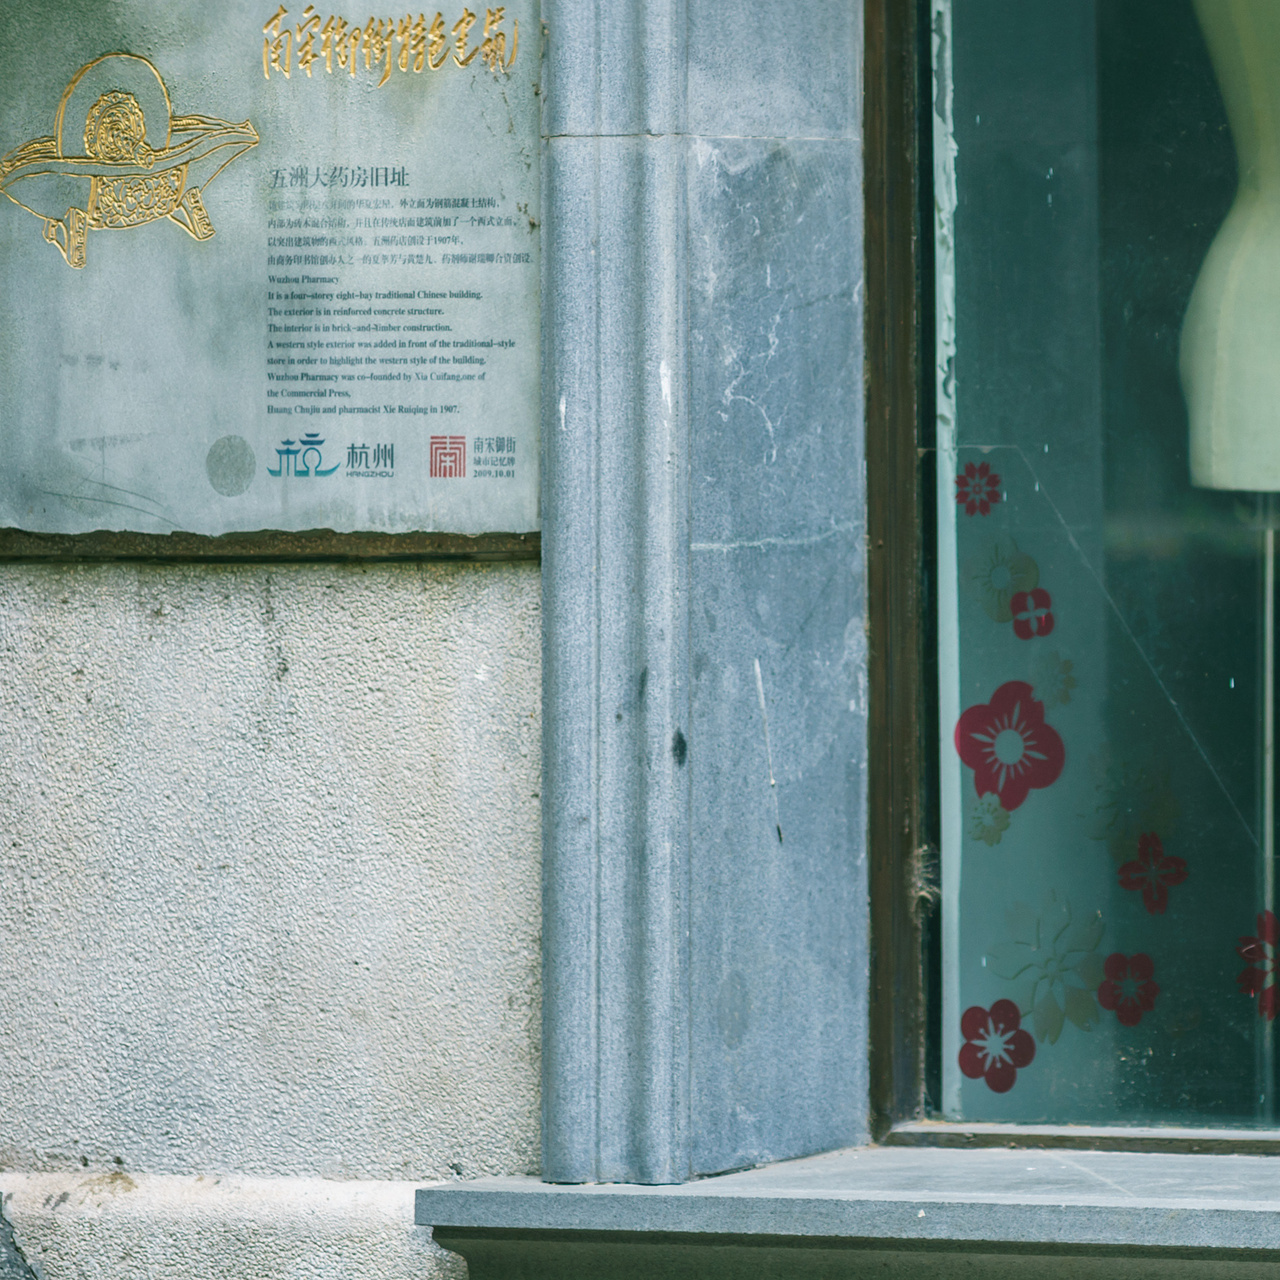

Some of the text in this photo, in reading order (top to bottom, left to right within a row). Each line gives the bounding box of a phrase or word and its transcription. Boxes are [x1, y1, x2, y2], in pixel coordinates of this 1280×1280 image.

[270, 166, 409, 188] 五洲大药房旧址
[268, 275, 339, 285] Wuzhou Pharmacy
[375, 291, 415, 299] traditional
[417, 290, 447, 299] Chinese
[449, 290, 483, 300] building.
[284, 307, 314, 316] exterior
[333, 307, 372, 316] reinforced
[373, 307, 406, 315] concrete
[407, 306, 444, 315] structure.
[284, 323, 312, 332] interior
[403, 322, 452, 331] construction.
[276, 340, 305, 349] western
[307, 340, 324, 350] style
[326, 340, 355, 348] exterior
[373, 339, 397, 348] added
[408, 339, 427, 348] front
[267, 357, 286, 365] store
[296, 356, 318, 365] order
[329, 356, 363, 366] highlight
[379, 356, 408, 364] western
[409, 356, 427, 366] style
[267, 372, 300, 381] Wuzhou
[301, 372, 339, 382] Pharmacy
[280, 389, 327, 397] Commercial
[267, 405, 292, 415] Huang
[294, 405, 321, 415] Chujiu
[338, 405, 381, 415] pharmacist
[398, 404, 428, 414] Ruiqing
[440, 404, 460, 412] 1907.
[473, 436, 516, 454] 南宋御街
[346, 443, 394, 469] 杭州
[473, 470, 515, 478] 2009.10.01
